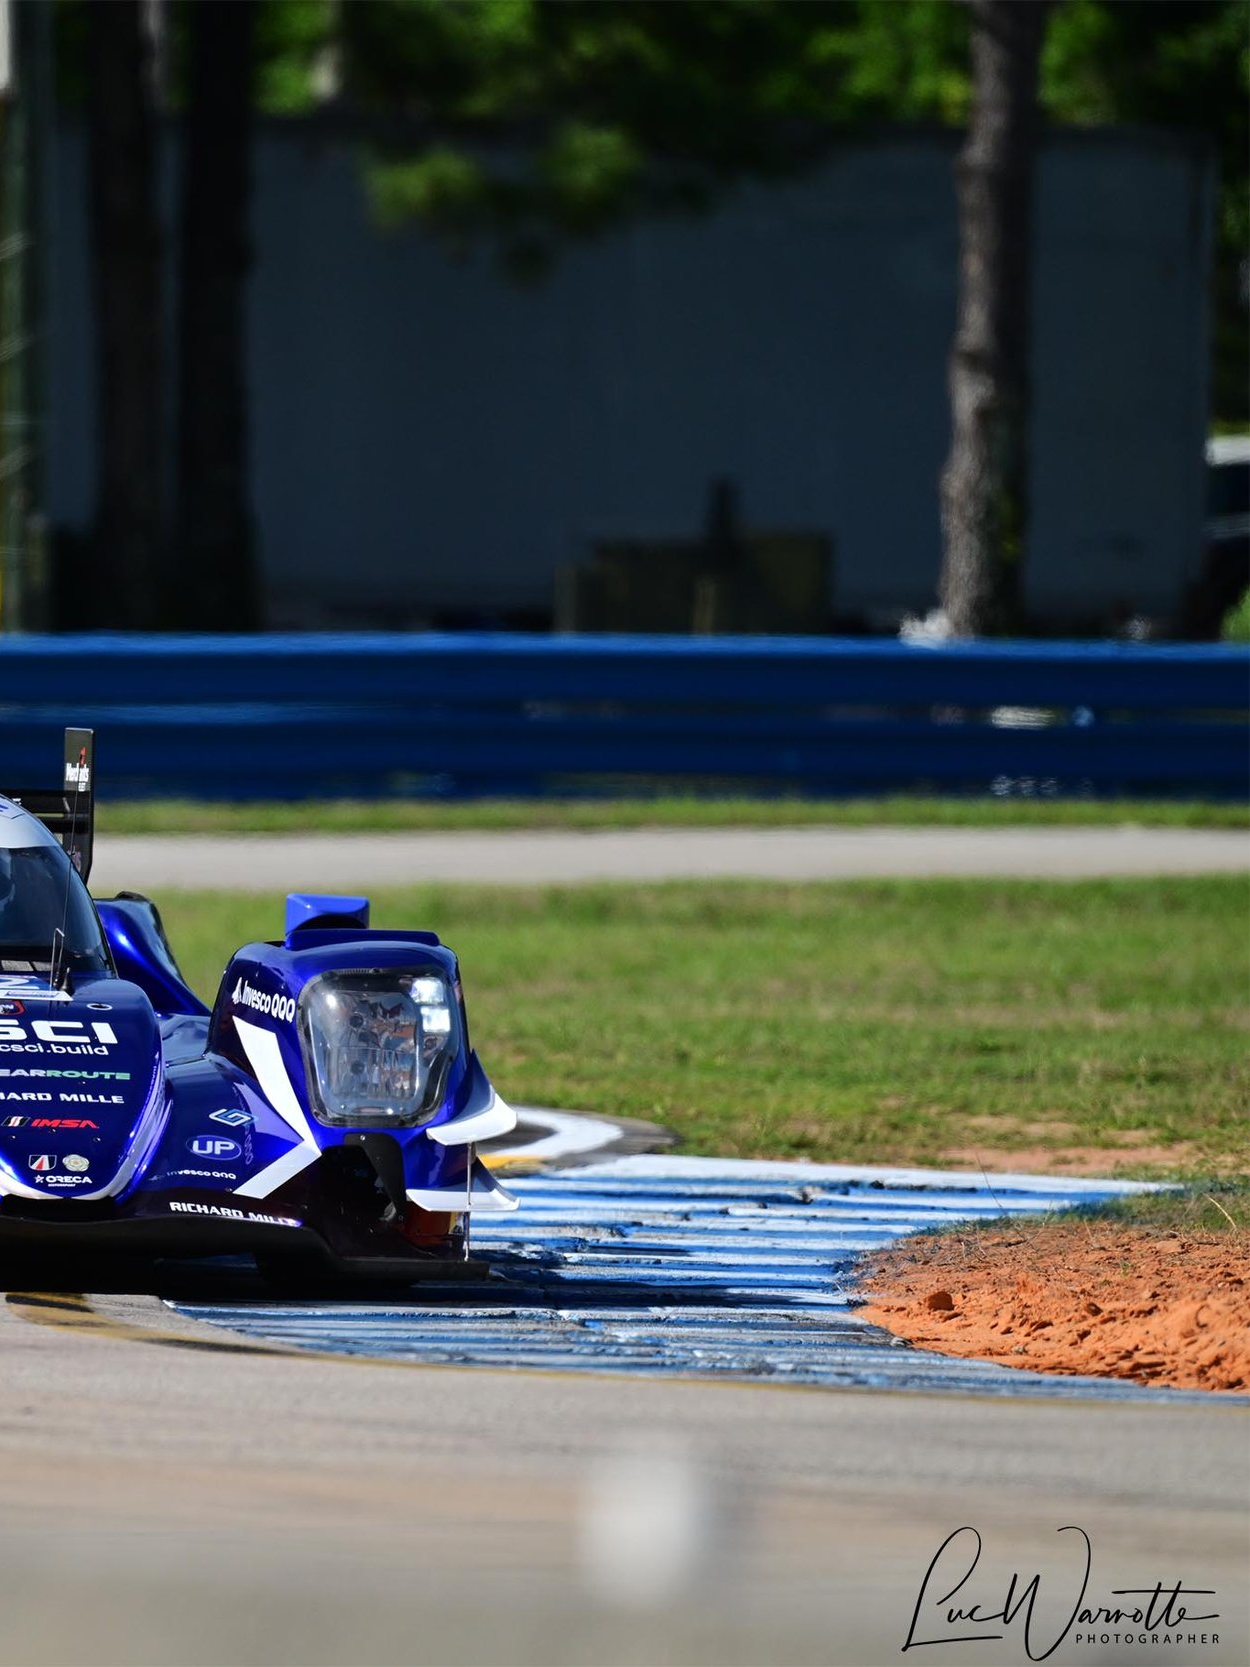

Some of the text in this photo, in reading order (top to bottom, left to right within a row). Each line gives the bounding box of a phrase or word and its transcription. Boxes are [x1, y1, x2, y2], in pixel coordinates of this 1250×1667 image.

[242, 980, 296, 1023] Invesco QQQ
[59, 1093, 125, 1104] MILLE
[31, 1118, 99, 1129] IMSA
[192, 1140, 235, 1154] UP
[45, 1175, 93, 1185] ORECA
[169, 1201, 244, 1219] RICHARD
